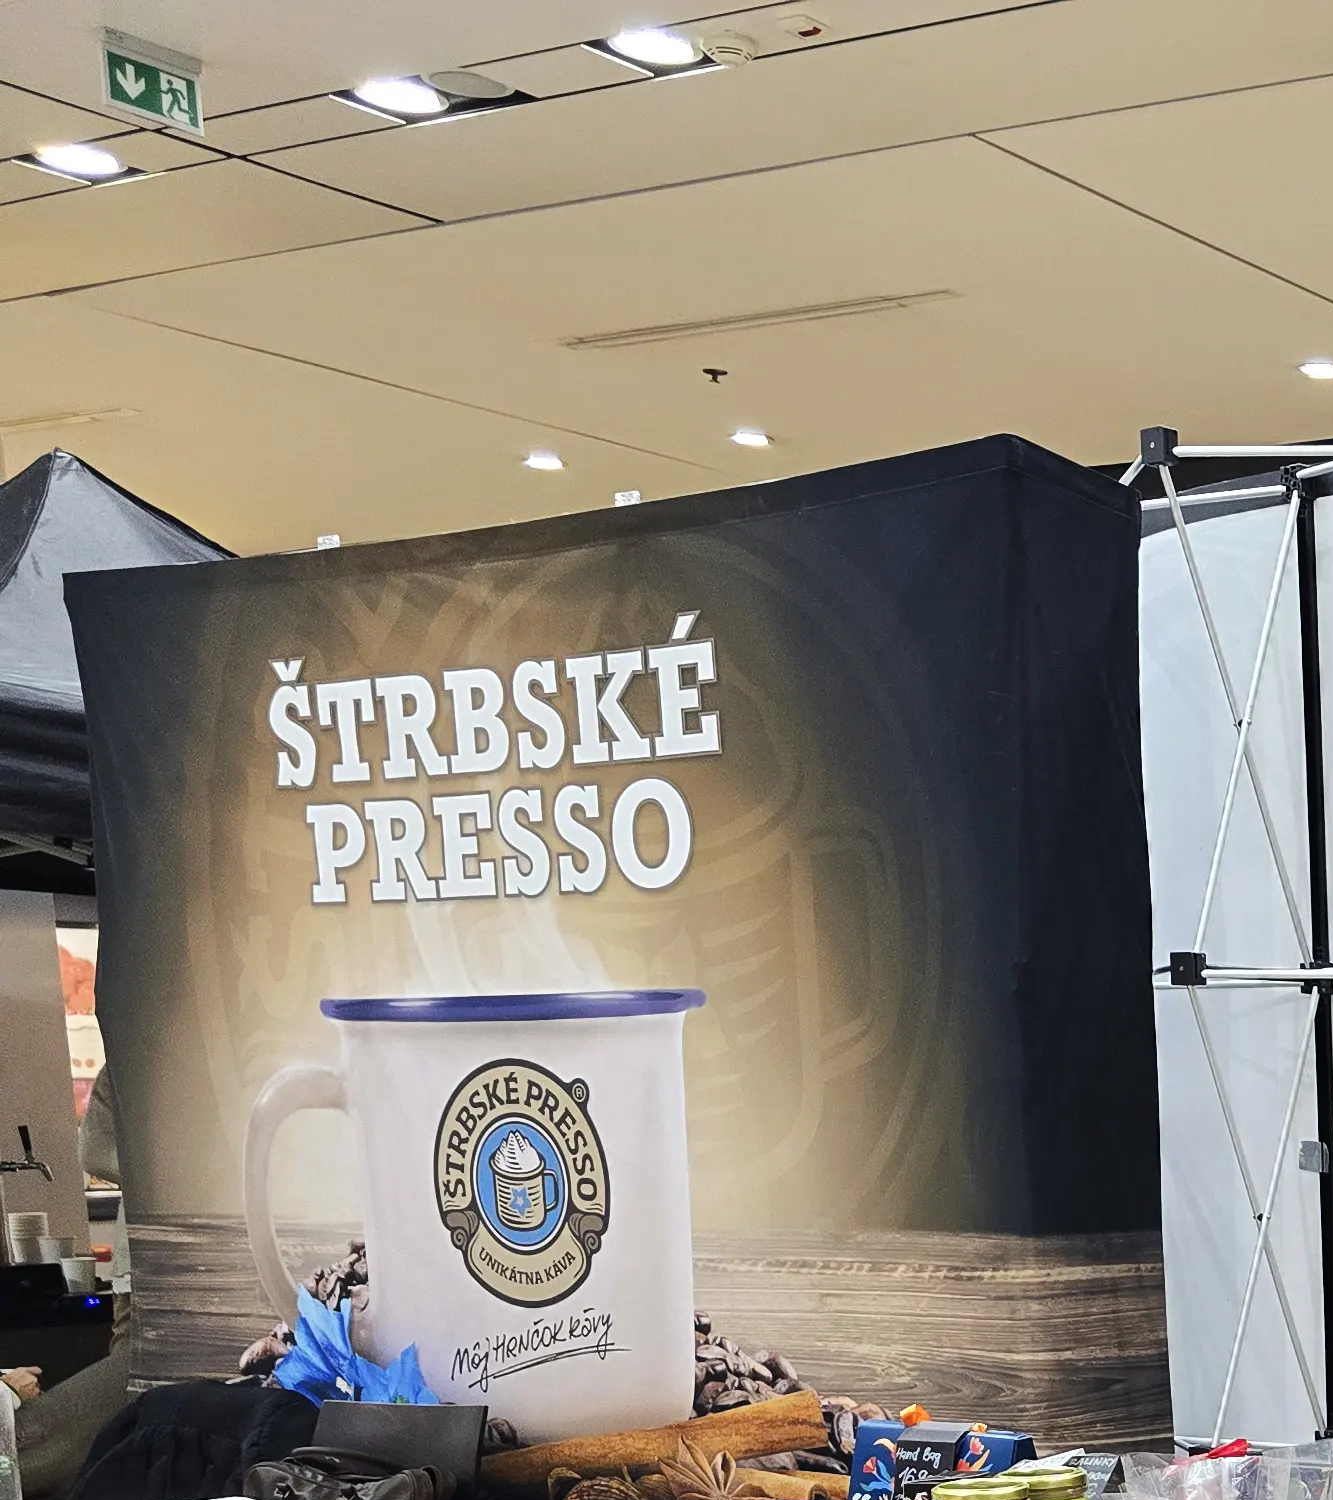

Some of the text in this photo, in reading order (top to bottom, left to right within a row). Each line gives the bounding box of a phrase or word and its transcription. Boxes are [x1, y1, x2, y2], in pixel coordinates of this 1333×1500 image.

[269, 611, 721, 789] ŠTRBSKÉ
[306, 777, 694, 904] PRESSO
[443, 1072, 599, 1202] ŠTRBSKÉ PRESSO
[478, 1247, 577, 1286] UNIKÁTNA KÁVA
